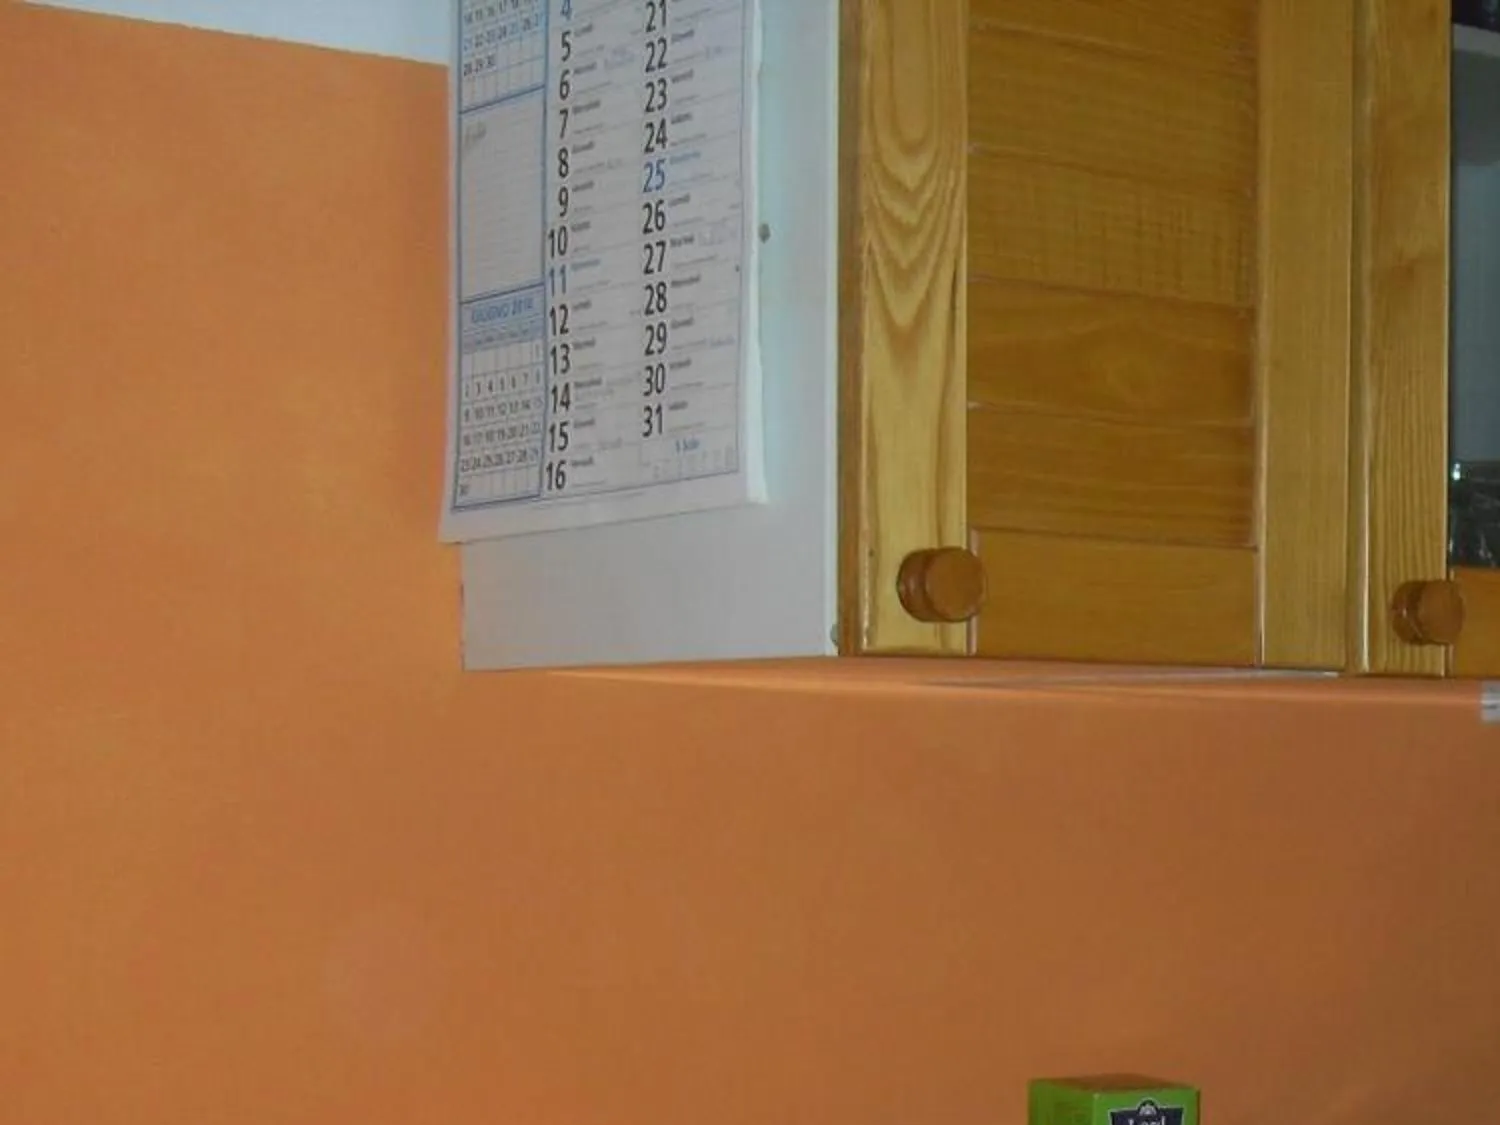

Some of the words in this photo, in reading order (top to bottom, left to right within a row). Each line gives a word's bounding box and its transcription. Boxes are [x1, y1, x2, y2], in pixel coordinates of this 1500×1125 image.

[645, 0, 667, 33] 21
[561, 30, 571, 62] 5
[645, 37, 667, 72] 22
[559, 69, 570, 101] 6
[644, 78, 667, 113] 23
[559, 108, 568, 139] 7
[644, 118, 668, 154] 24
[558, 147, 569, 178] 8
[642, 158, 667, 193] 25
[558, 186, 568, 218] 9
[642, 199, 666, 235] 26
[548, 226, 568, 259] 10
[643, 240, 667, 275] 27
[549, 264, 567, 297] 11
[644, 281, 667, 316] 28
[549, 304, 569, 337] 12
[644, 321, 667, 356] 29
[550, 343, 570, 376] 13
[642, 362, 666, 397] 30
[551, 382, 571, 414] 14
[642, 402, 664, 438] 31
[549, 421, 569, 453] 15
[546, 459, 566, 490] 16
